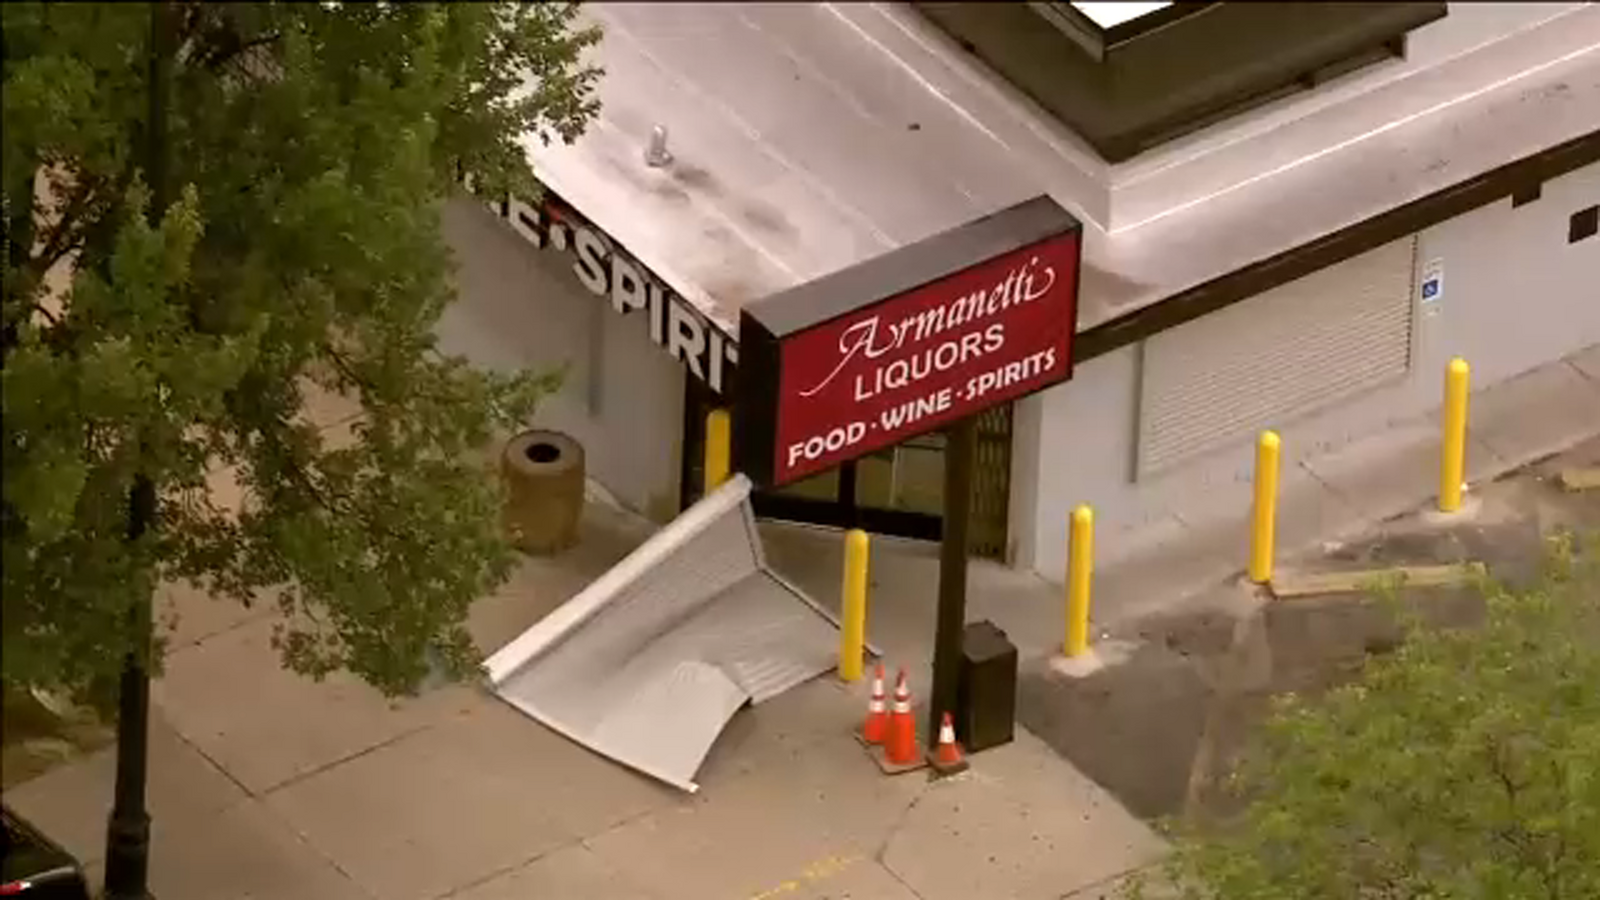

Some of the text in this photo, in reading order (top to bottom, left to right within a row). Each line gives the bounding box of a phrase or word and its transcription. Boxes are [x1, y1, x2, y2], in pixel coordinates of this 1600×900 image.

[799, 256, 1056, 396] Armanetti
[854, 323, 1005, 402] LIQUORS
[787, 347, 1056, 467] FOOD WINE SPIRITS
